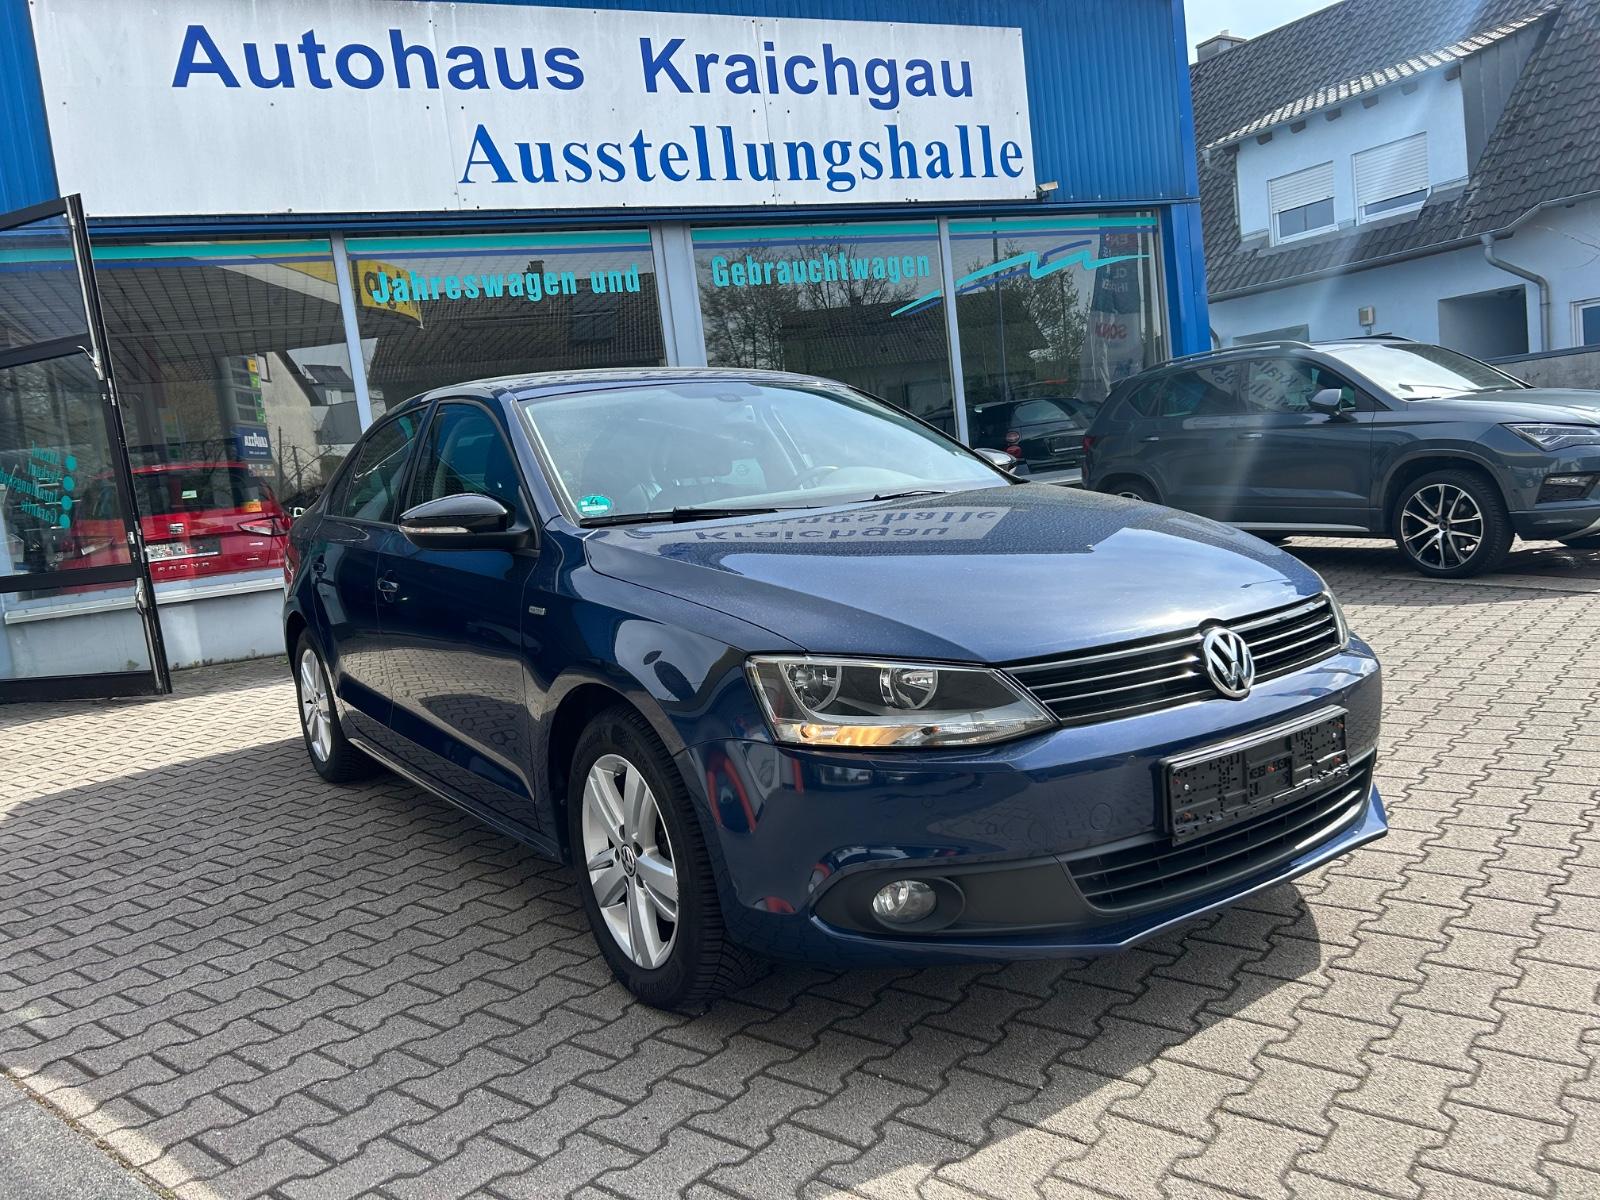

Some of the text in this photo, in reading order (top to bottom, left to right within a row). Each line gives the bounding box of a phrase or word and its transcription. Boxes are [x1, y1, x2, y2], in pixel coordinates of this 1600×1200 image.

[172, 24, 973, 111] Autohaus Kraichgau
[459, 123, 1024, 193] Ausstellungshalle
[371, 263, 641, 303] Jahreswagen und
[711, 250, 930, 288] Gebrauchtwagen
